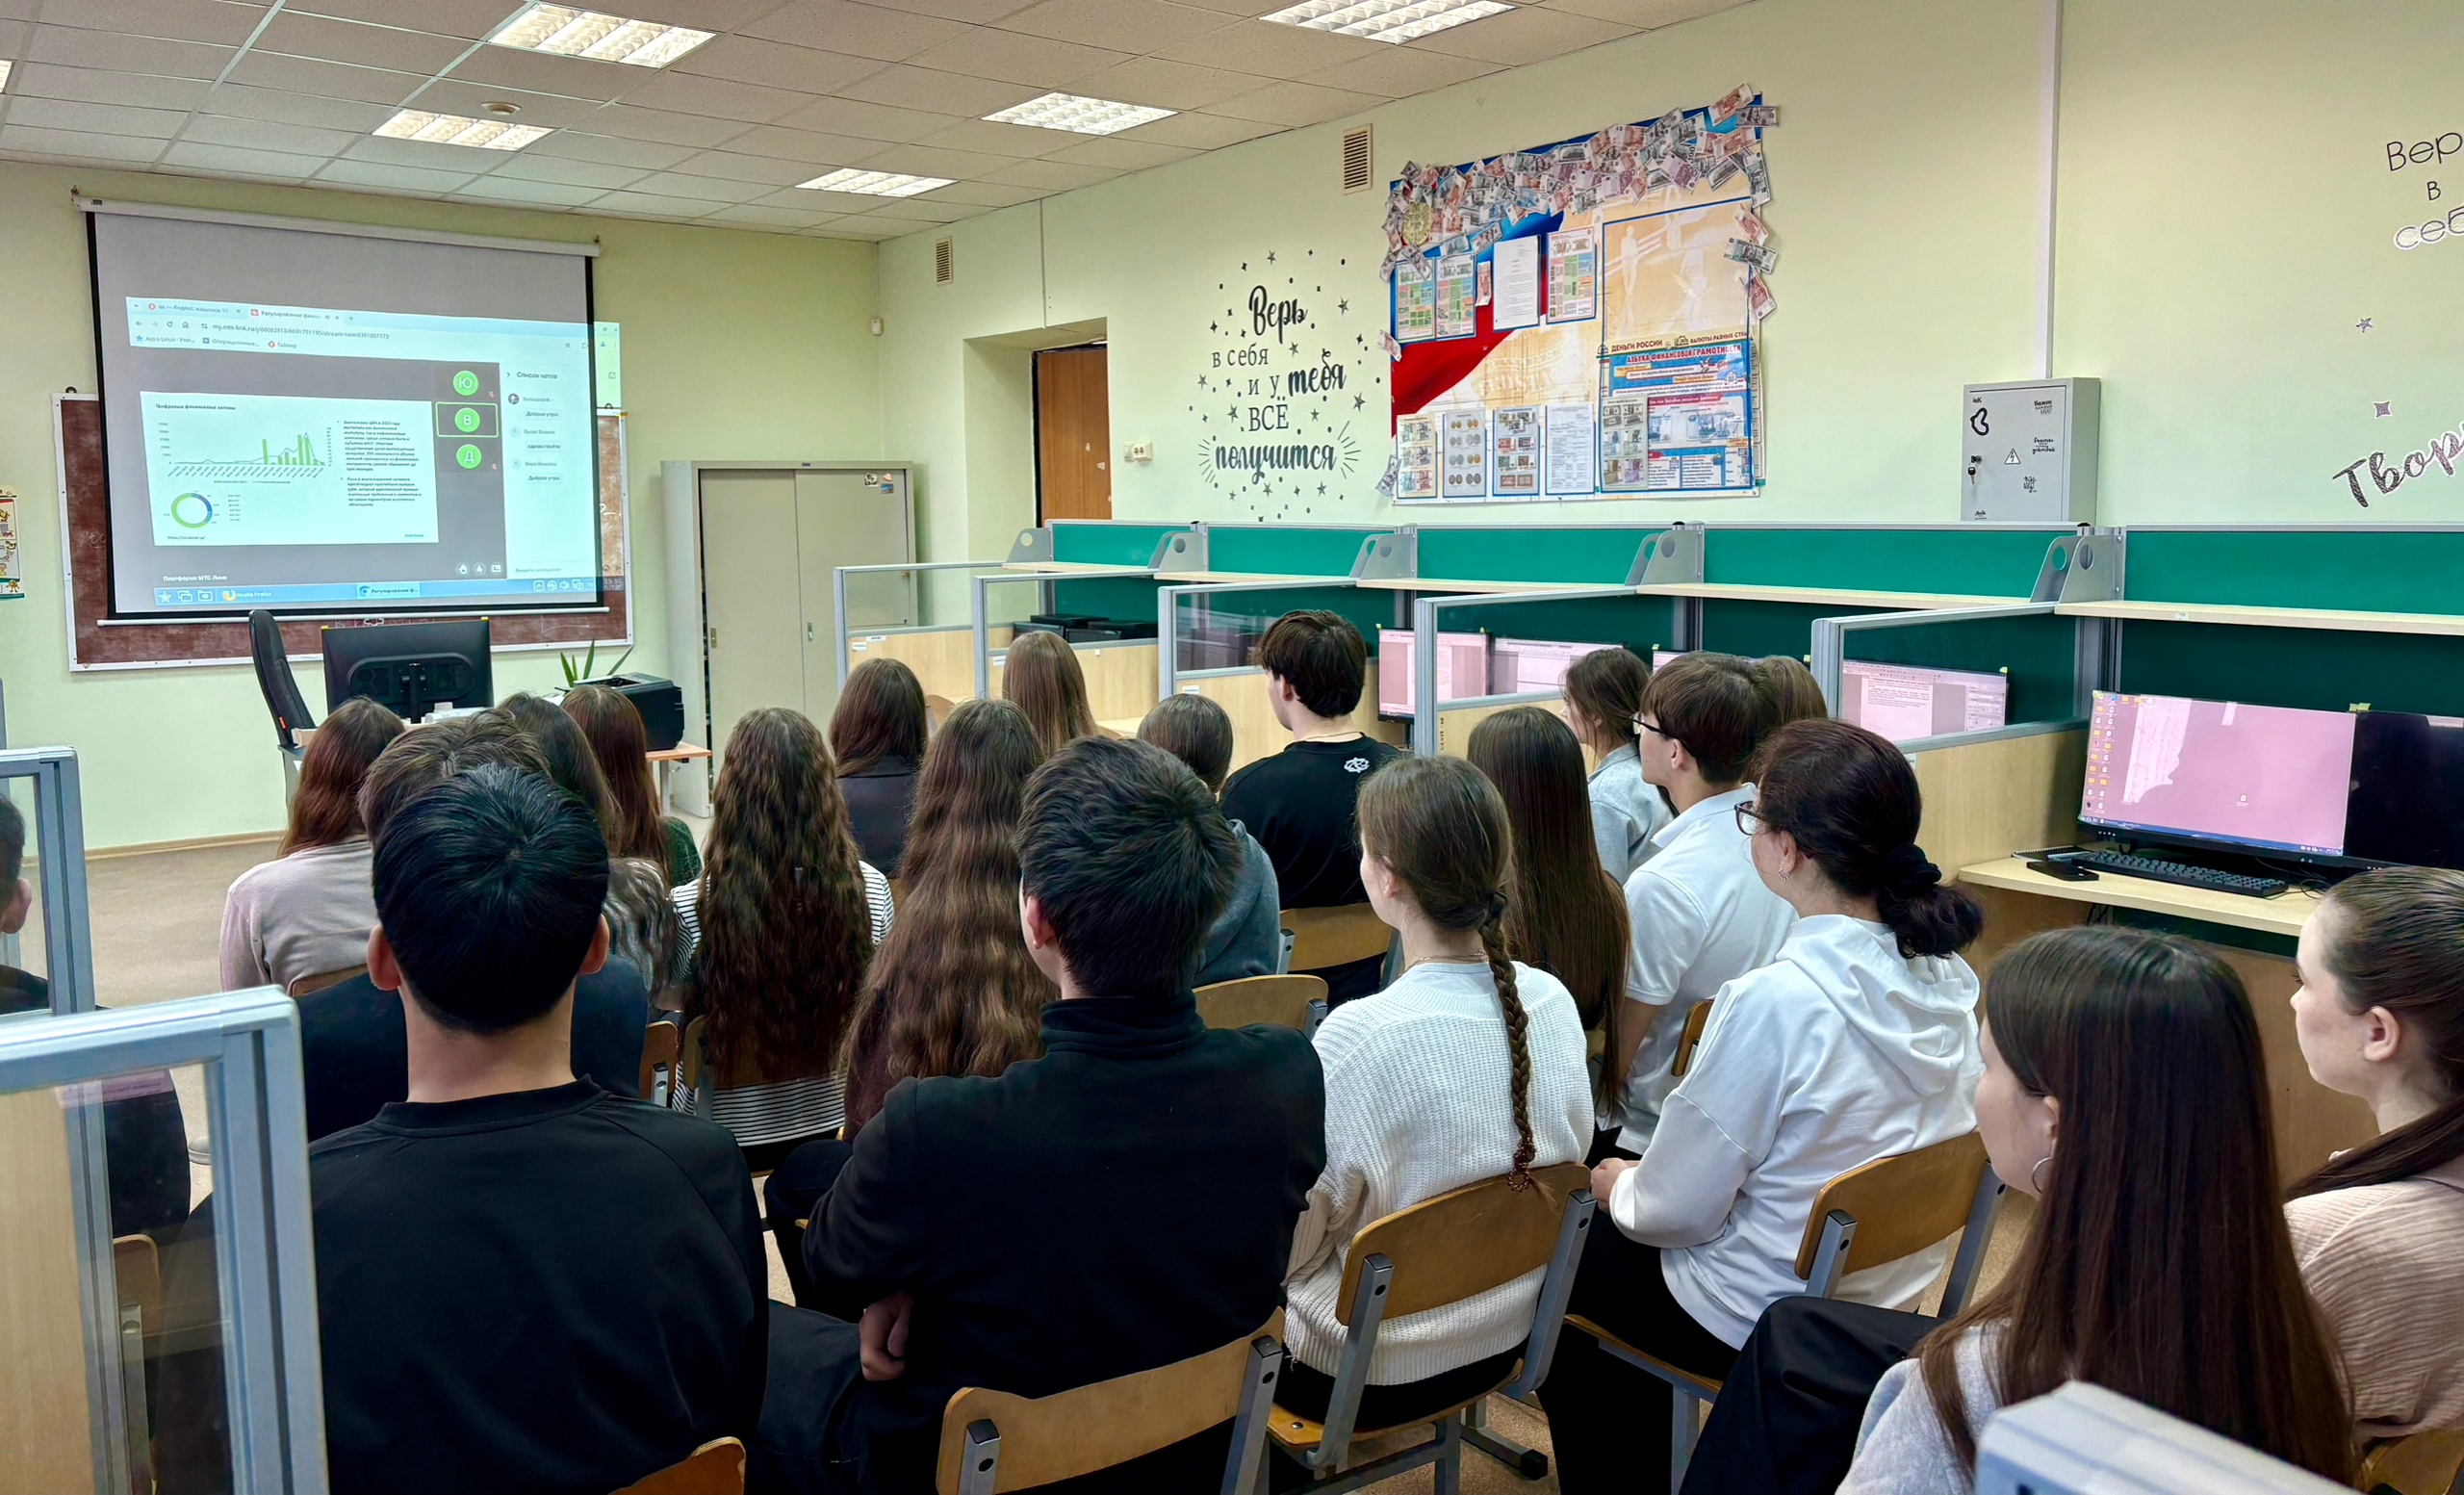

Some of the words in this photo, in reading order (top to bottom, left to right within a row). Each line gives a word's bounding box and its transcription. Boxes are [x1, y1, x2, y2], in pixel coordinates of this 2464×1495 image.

[2386, 131, 2464, 171] Вер
[2395, 205, 2464, 249] себ
[1248, 285, 1309, 345] Верь
[1611, 342, 1636, 353] ДЕНЬГИ
[1636, 339, 1663, 349] РОССИИ
[1690, 334, 1713, 344] ВАЛЮТЫ
[1713, 332, 1733, 341] РАЗНЫХ
[1212, 351, 1221, 368] в
[1226, 343, 1270, 367] себя
[1627, 352, 1651, 363] АЗБУКА
[1651, 348, 1692, 361] ФИНАНСОВОЙ
[1692, 344, 1742, 356] ГРАМОТНОСТИ
[459, 377, 473, 388] Ю
[1248, 378, 1260, 396] и
[1270, 374, 1280, 399] у
[1287, 348, 1348, 397] тебя
[463, 415, 473, 425] В
[1248, 396, 1289, 431] ВСЁ
[463, 451, 475, 464] Д
[1215, 444, 1337, 485] получится
[2332, 422, 2464, 508] Твор
